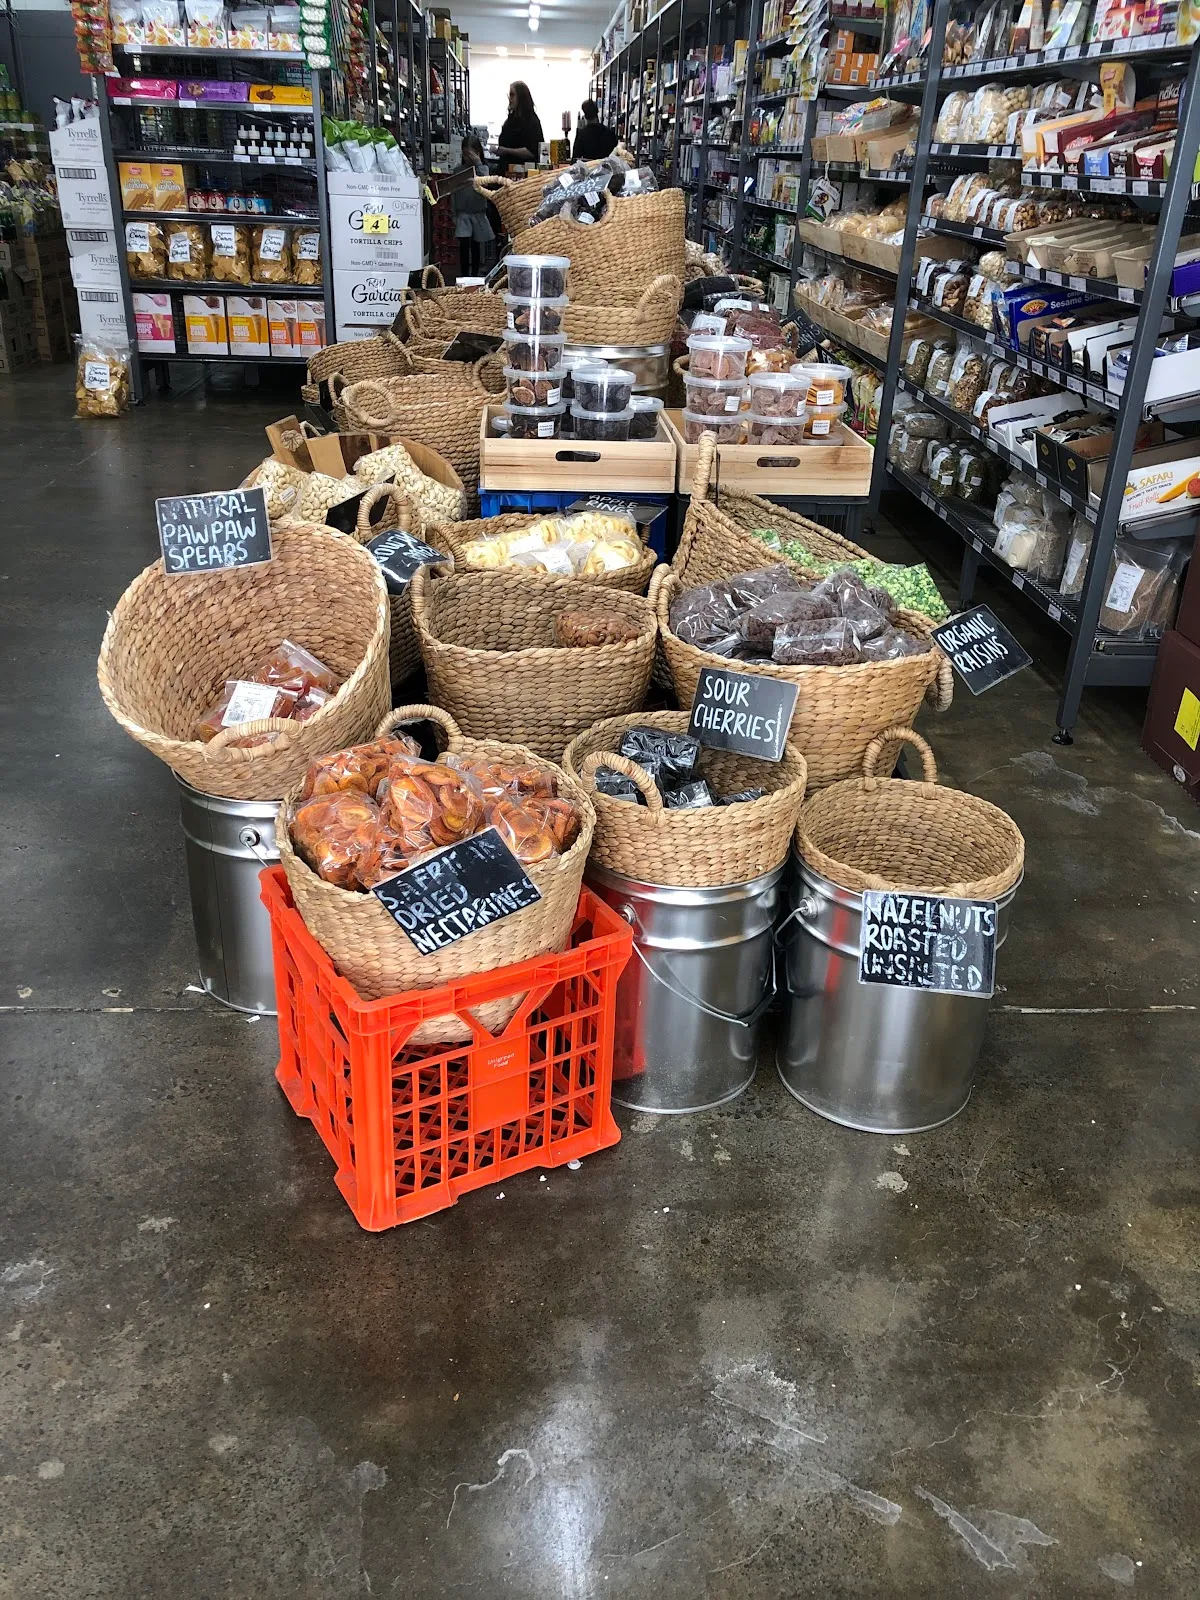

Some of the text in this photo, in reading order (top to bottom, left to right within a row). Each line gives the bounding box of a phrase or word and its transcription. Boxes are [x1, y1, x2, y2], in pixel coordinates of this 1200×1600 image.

[351, 284, 401, 303] Garcia
[1050, 296, 1083, 309] Sesame
[1139, 472, 1174, 488] SAFARI
[586, 500, 635, 517] RINGS
[588, 495, 639, 509] APPLE
[1145, 491, 1160, 504] Rolls
[168, 540, 248, 570] SPEARS
[937, 613, 995, 653] ORGANIC
[953, 635, 1009, 674] RAISINS
[702, 675, 751, 707] SOUR
[693, 703, 776, 743] CHERRIES
[393, 882, 469, 930] DRIED
[865, 923, 968, 961] ROASTED
